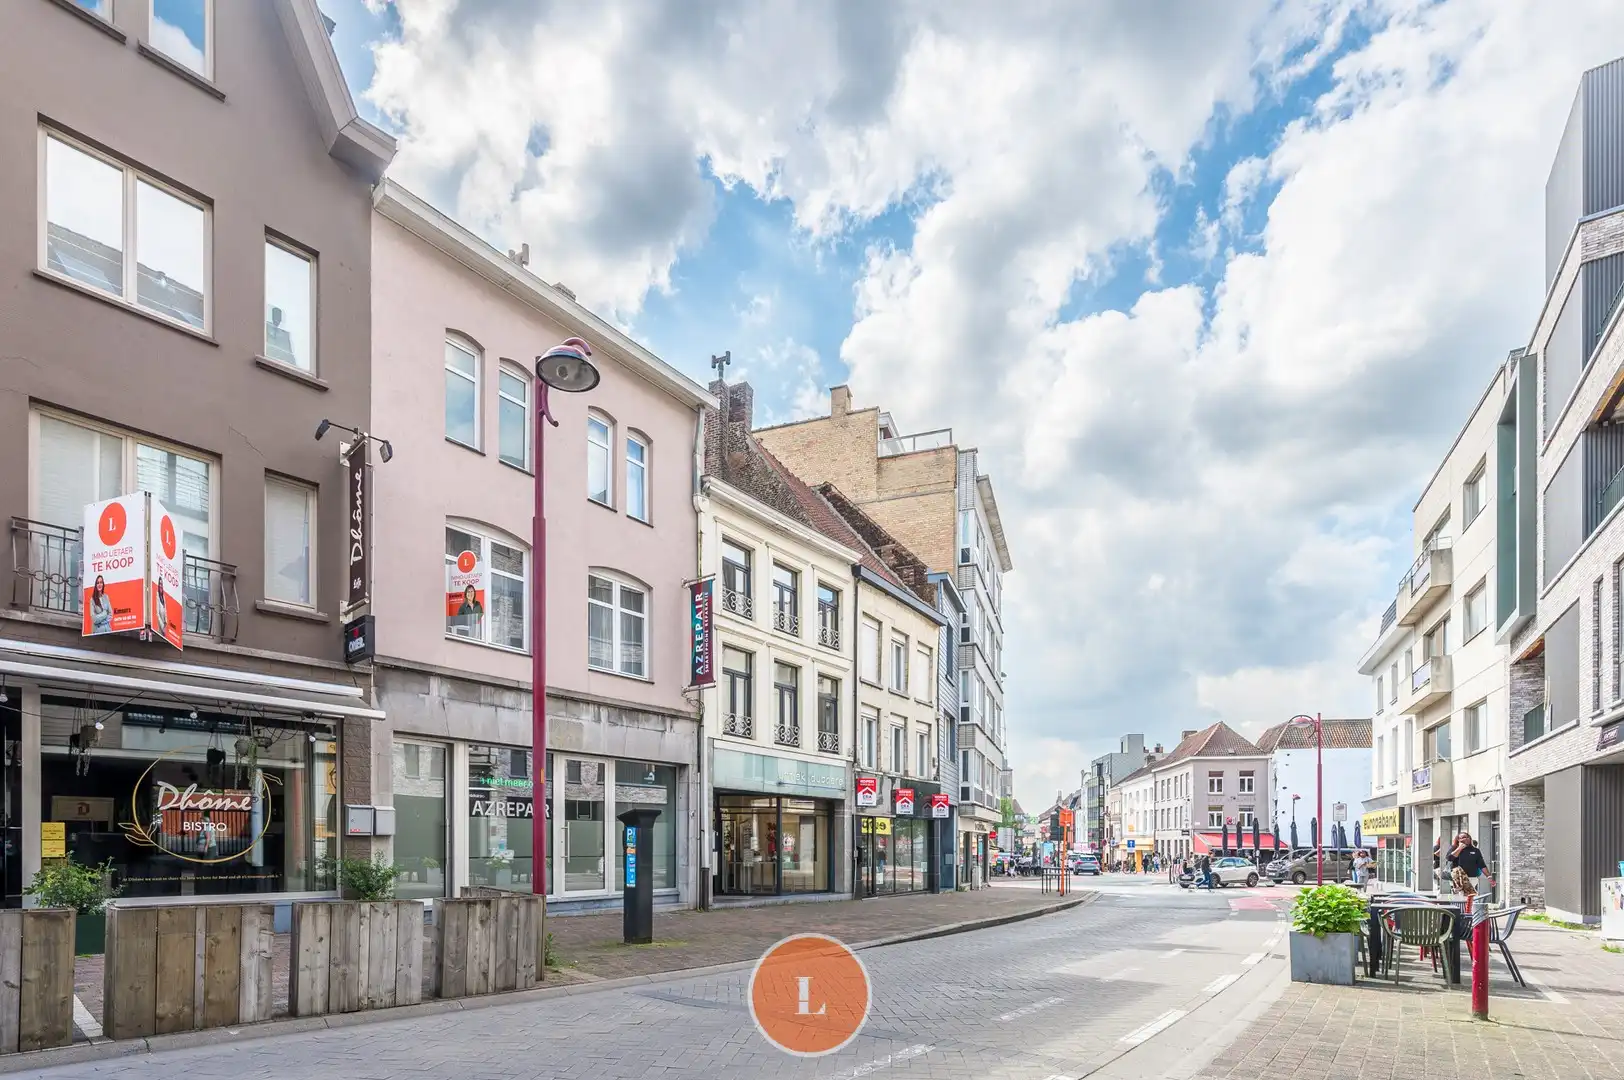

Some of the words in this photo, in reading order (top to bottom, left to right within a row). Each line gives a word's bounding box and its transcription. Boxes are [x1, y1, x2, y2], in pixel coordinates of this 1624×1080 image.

[92, 562, 103, 573] TE
[105, 556, 134, 570] KOOP
[695, 592, 704, 675] AZREPAIR
[157, 781, 252, 810] Dhôme
[471, 800, 550, 818] AZREPAR
[183, 822, 227, 832] BISTRO
[1364, 811, 1397, 831] europabank
